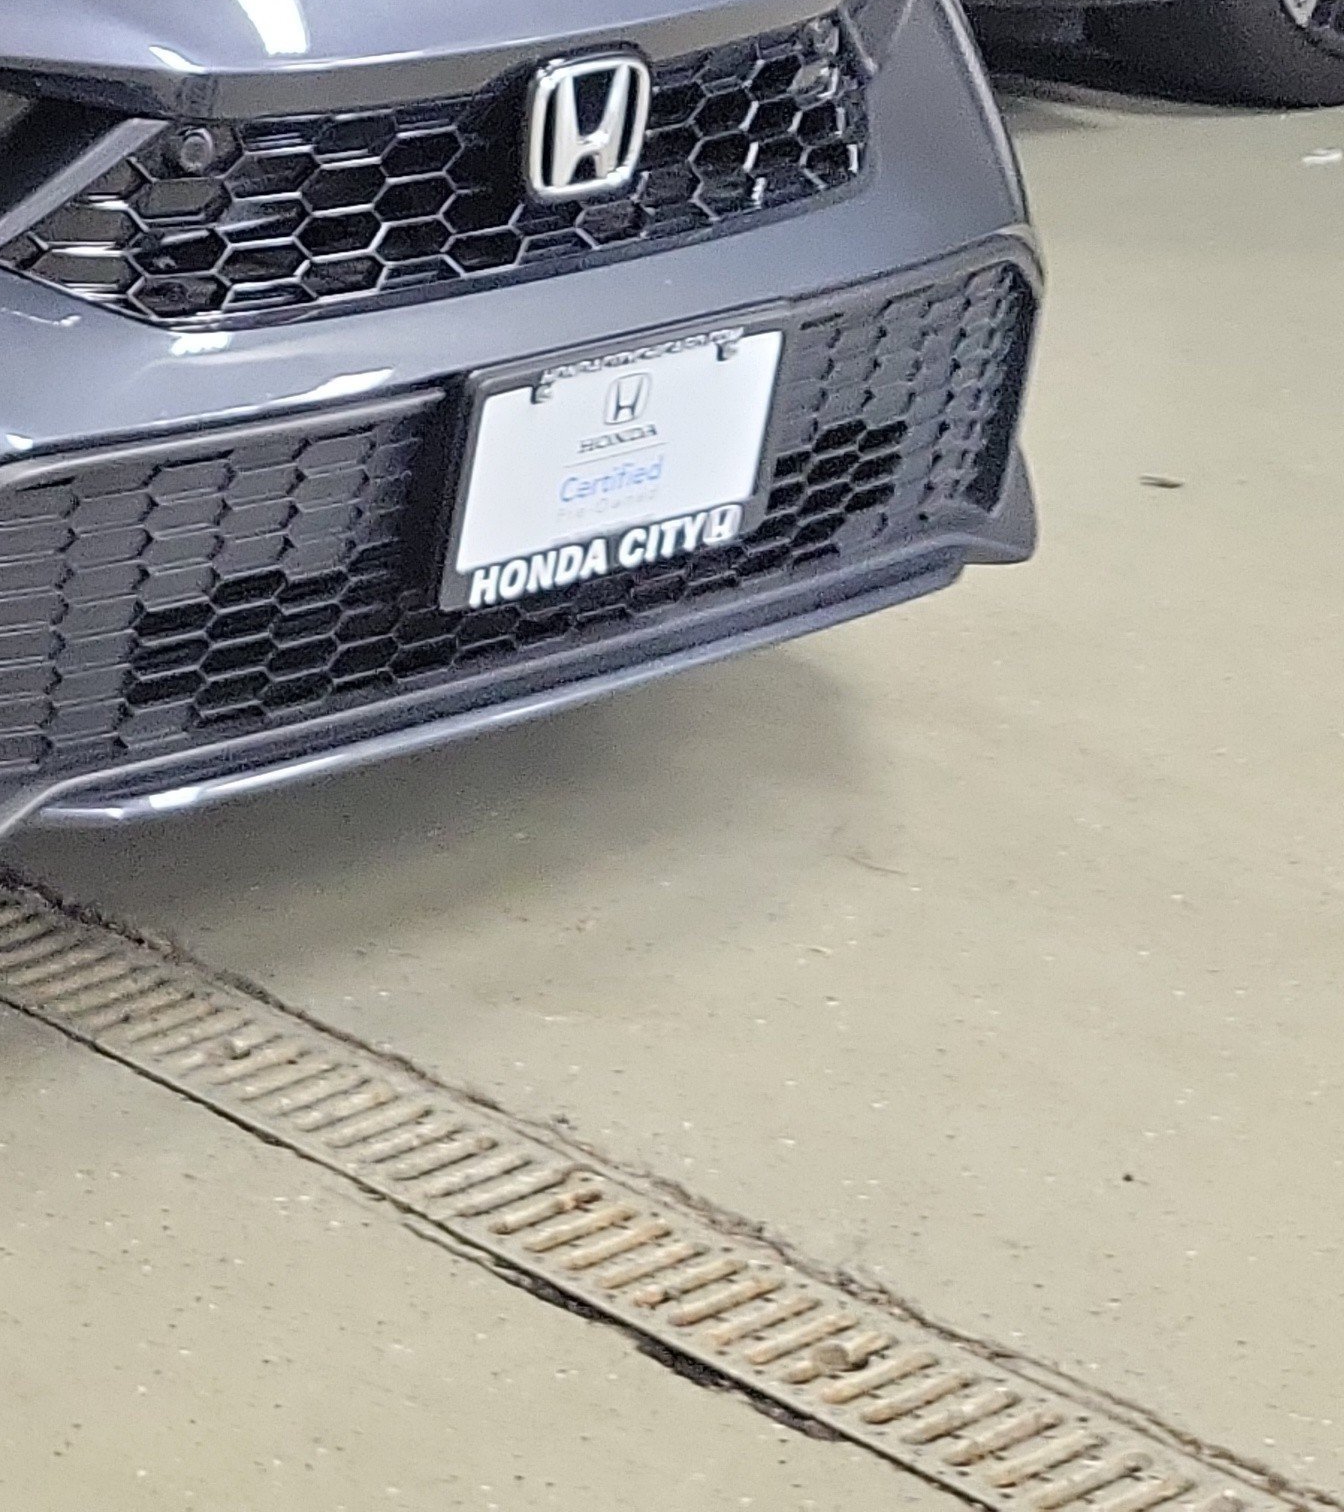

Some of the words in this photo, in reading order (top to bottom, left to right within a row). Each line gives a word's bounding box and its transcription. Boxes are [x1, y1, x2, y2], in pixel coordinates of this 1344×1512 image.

[559, 453, 664, 502] Certified
[468, 537, 609, 609] HONDA
[618, 510, 708, 569] CITY
